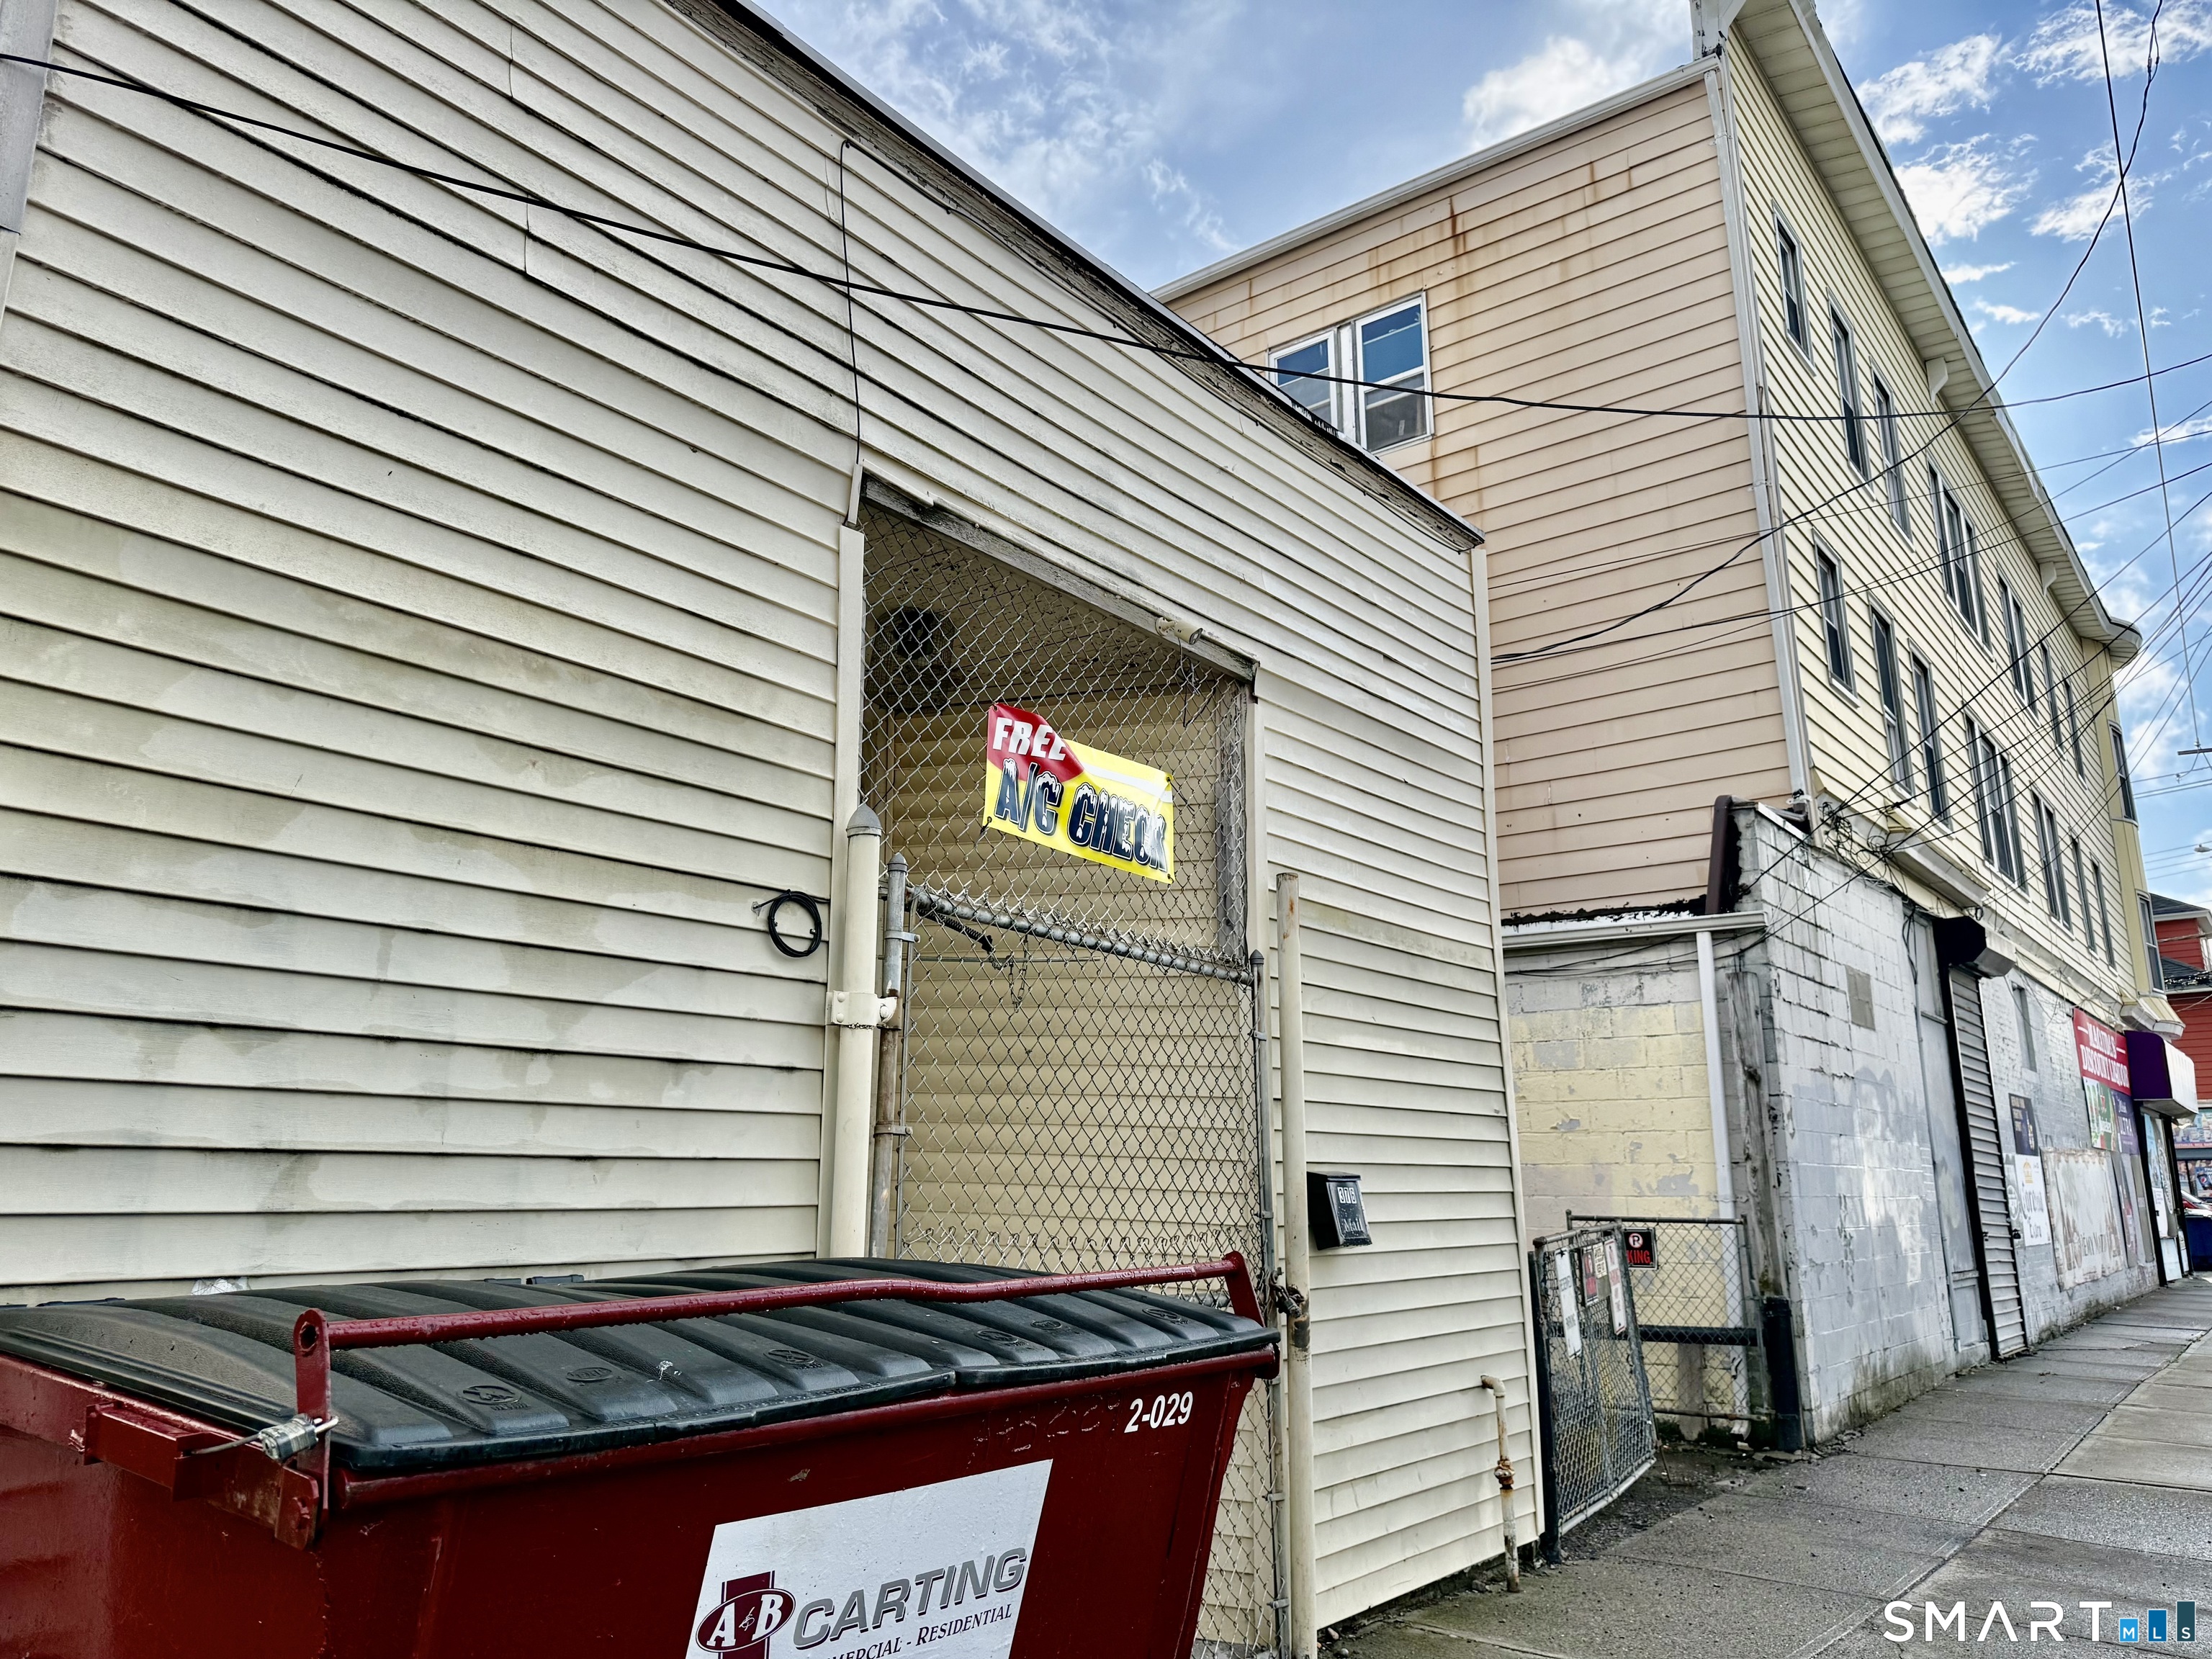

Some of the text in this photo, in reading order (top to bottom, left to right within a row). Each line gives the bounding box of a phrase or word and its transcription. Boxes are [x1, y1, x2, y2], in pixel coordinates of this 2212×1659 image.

[994, 757, 1167, 873] A/C CHECK
[2080, 1044, 2130, 1089] DISCOUNT LIQUOR
[2021, 1182, 2044, 1220] Corona
[1343, 1217, 1364, 1232] Mail
[1124, 1391, 1193, 1433] 2-029
[793, 1547, 1027, 1649] CARTING
